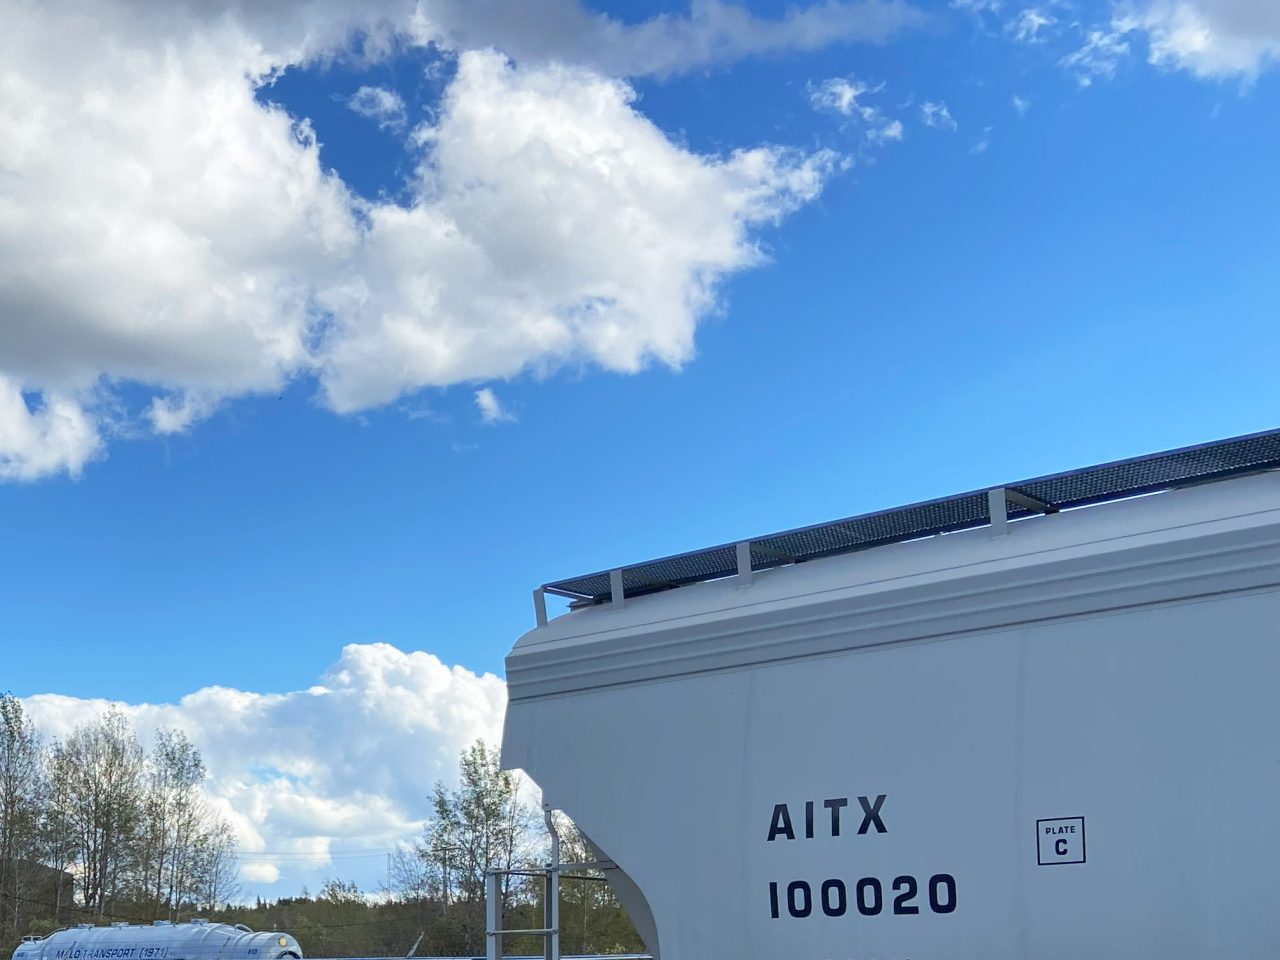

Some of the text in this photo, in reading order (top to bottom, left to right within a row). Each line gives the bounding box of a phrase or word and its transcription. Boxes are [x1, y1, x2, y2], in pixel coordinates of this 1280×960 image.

[766, 794, 888, 842] AITX
[1044, 825, 1076, 836] PLATE
[1054, 838, 1069, 856] C
[768, 873, 958, 919] 100020
[83, 948, 135, 960] TRANSPORT
[138, 946, 169, 959] (1971)
